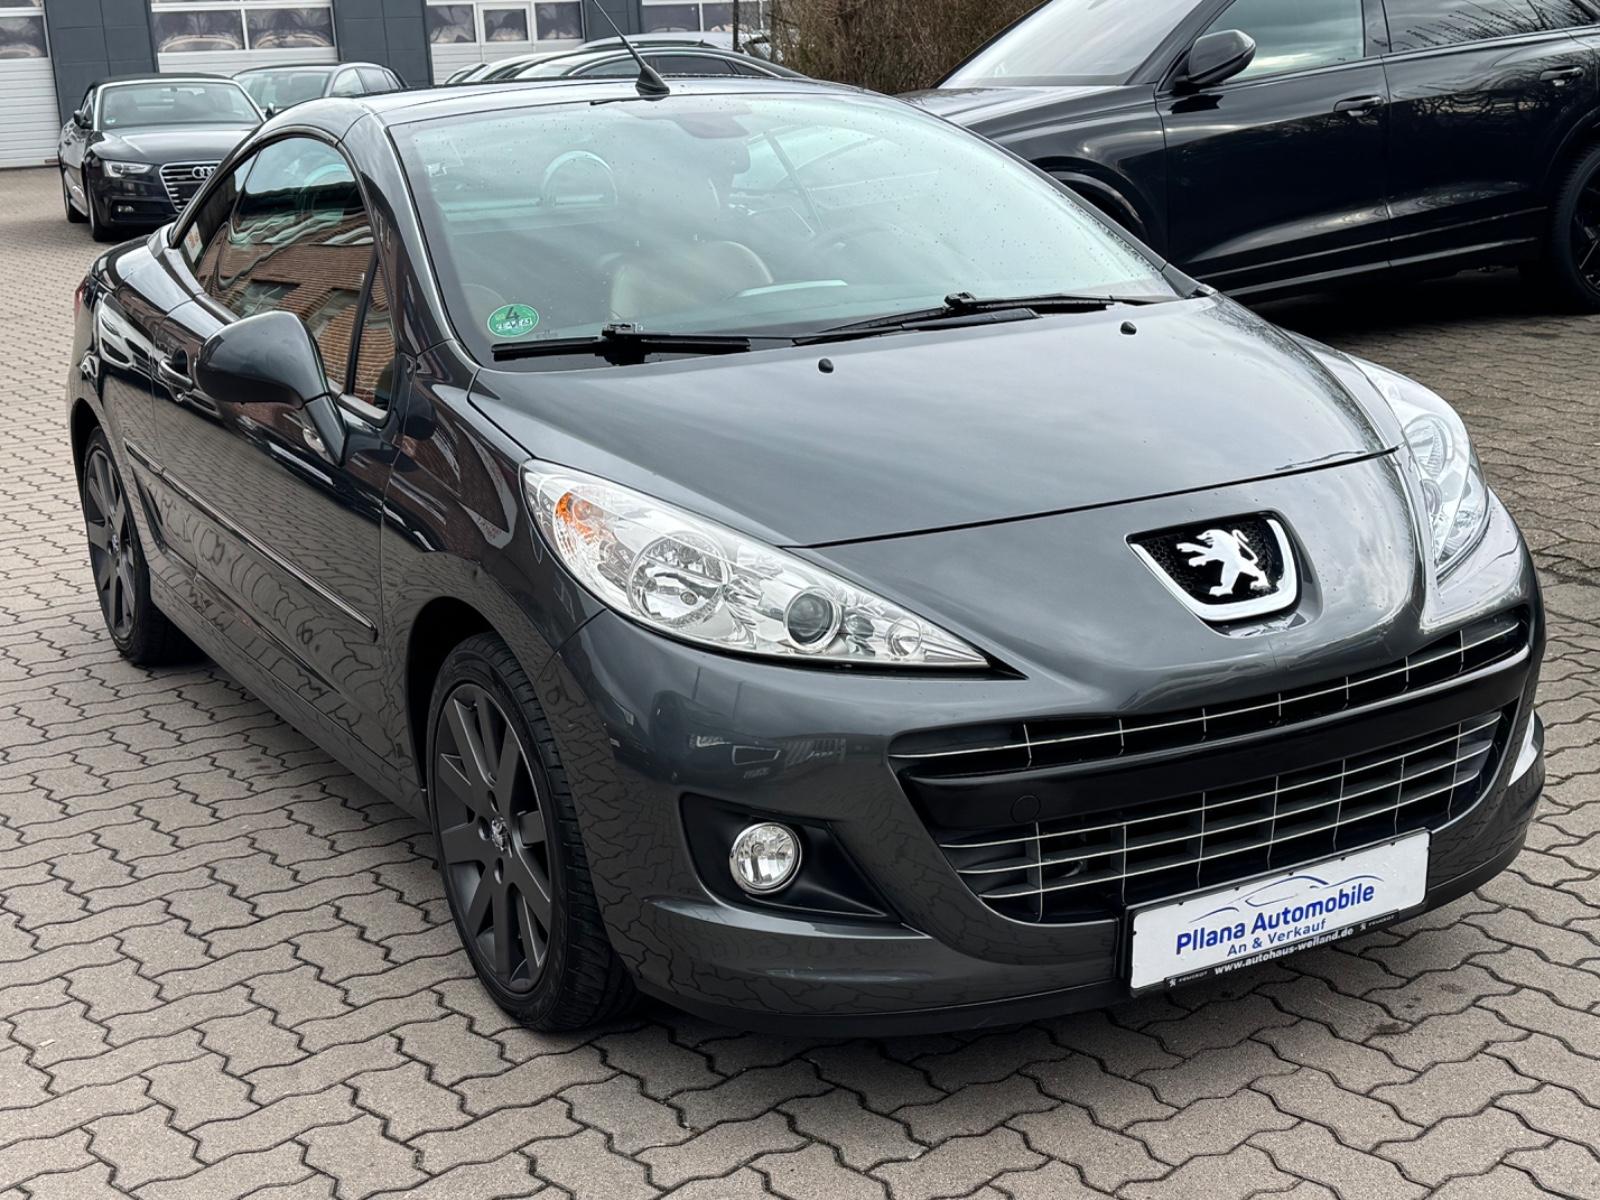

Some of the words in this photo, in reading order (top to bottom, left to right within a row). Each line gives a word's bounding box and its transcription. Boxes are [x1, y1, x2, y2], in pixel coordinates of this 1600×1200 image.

[505, 306, 520, 320] 4
[1176, 922, 1245, 955] Pllana
[1251, 883, 1375, 934] Automobile
[1227, 940, 1247, 957] An
[1252, 937, 1263, 950] &
[1268, 918, 1327, 944] Verkauf
[1214, 928, 1354, 975] www.autohaus-weiland.de
